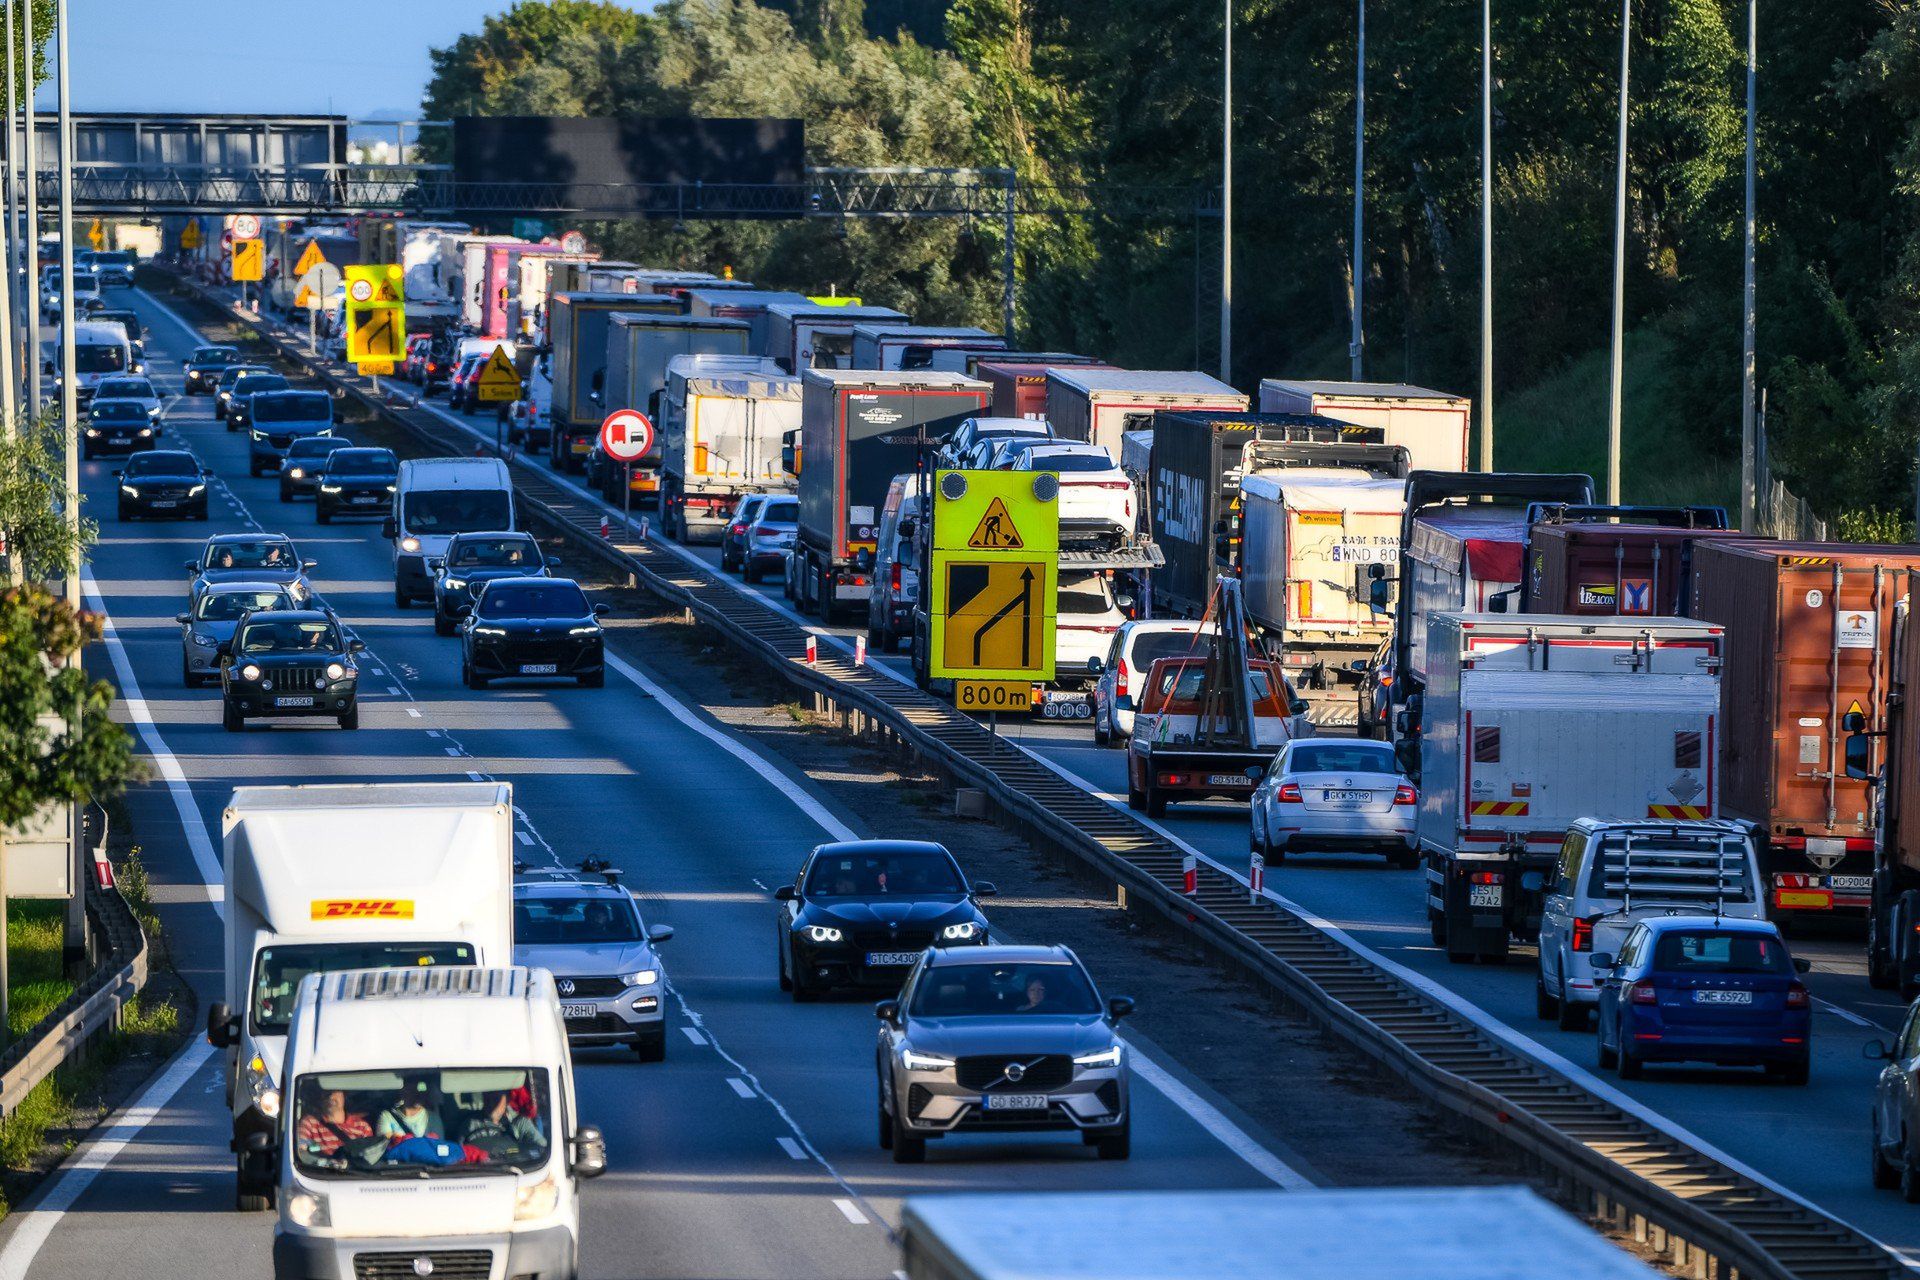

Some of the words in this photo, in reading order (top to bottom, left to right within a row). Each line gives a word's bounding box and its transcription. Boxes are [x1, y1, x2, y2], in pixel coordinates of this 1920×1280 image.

[1342, 547, 1372, 561] WND
[1379, 548, 1401, 561] 80
[1584, 591, 1615, 605] BEACON
[962, 685, 1027, 706] 800m
[1045, 704, 1058, 717] 60
[1061, 704, 1074, 717] 80
[1076, 704, 1090, 717] 90
[1848, 877, 1873, 887] 9004
[1472, 896, 1500, 906] 73A2
[325, 902, 400, 916] DHL
[561, 1005, 595, 1016] 728HU
